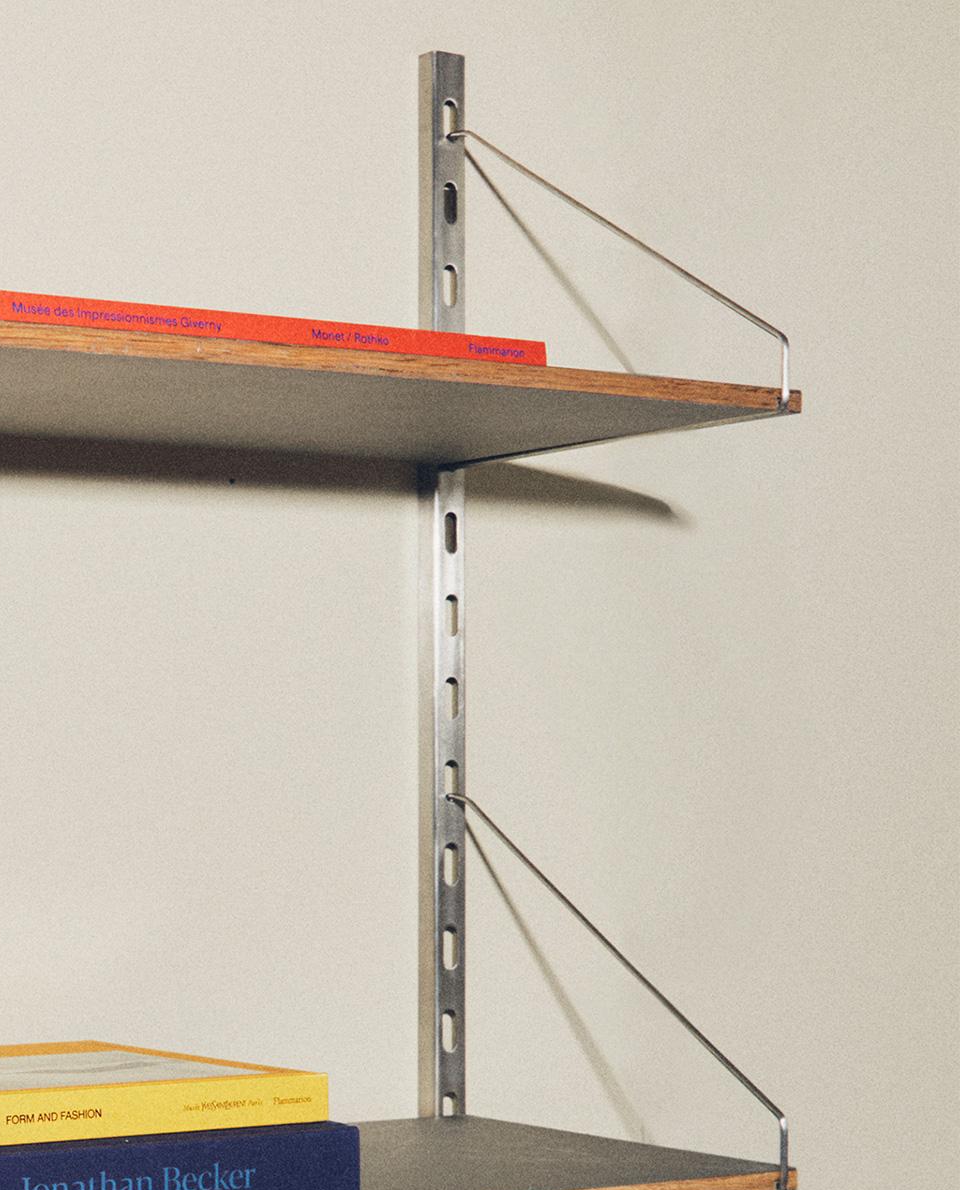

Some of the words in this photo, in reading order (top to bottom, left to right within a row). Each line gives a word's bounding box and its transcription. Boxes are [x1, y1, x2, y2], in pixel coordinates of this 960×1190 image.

[12, 302, 51, 316] Musée
[54, 306, 75, 318] des
[77, 304, 178, 327] Impressionnismes
[180, 316, 222, 332] Giverny
[311, 328, 346, 342] Monet
[354, 331, 390, 346] Rothko
[5, 1113, 35, 1126] FORM
[37, 1111, 58, 1123] AND
[60, 1108, 103, 1121] FASHION
